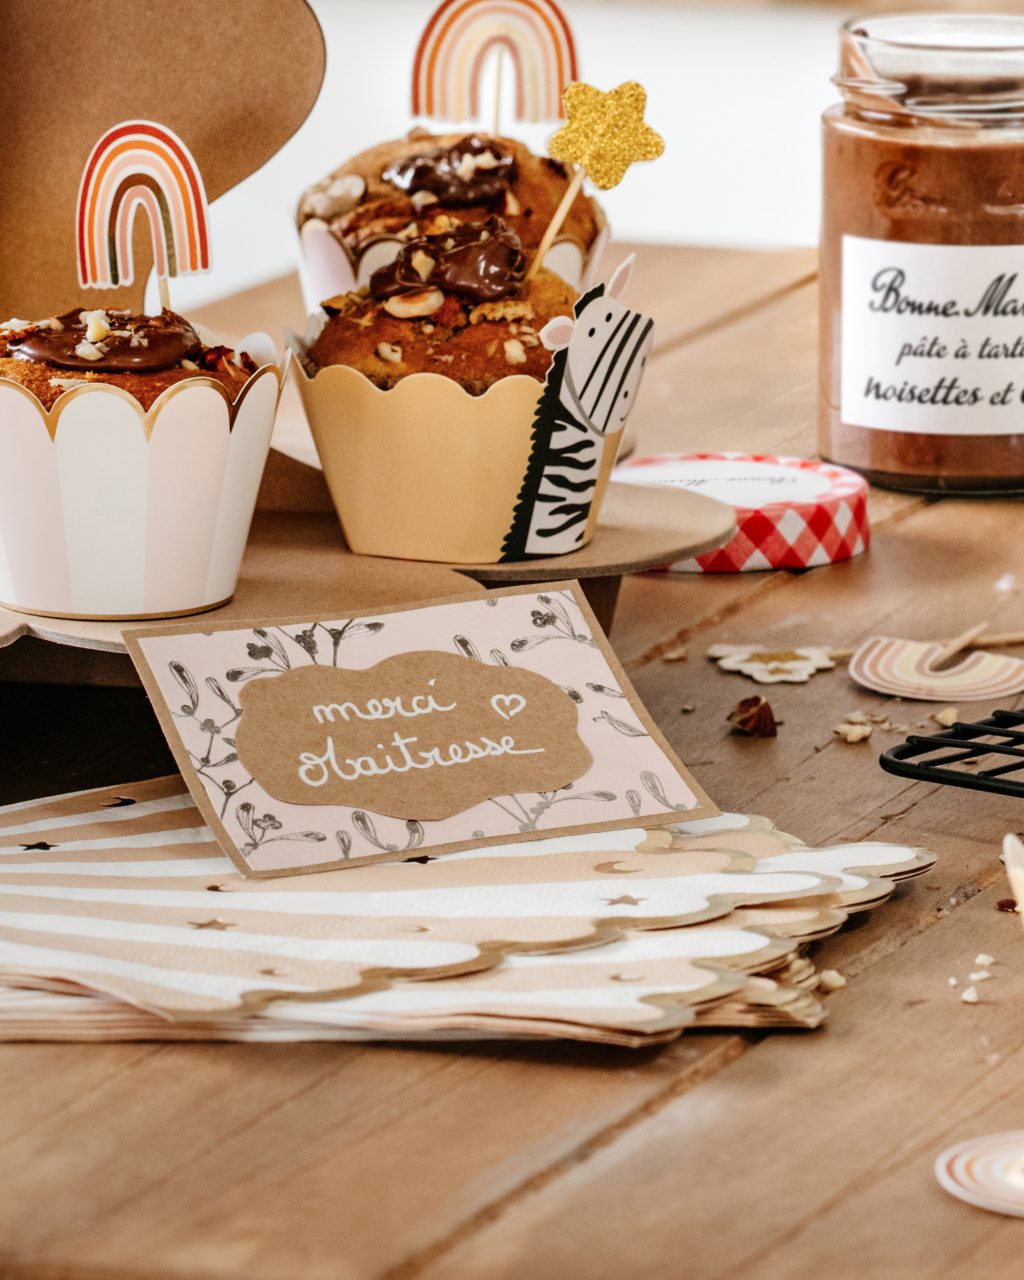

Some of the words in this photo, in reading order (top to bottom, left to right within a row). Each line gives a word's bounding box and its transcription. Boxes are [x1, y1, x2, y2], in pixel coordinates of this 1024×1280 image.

[869, 266, 961, 318] Bonne
[895, 335, 948, 366] pâte
[954, 338, 971, 360] à
[989, 382, 1014, 407] et
